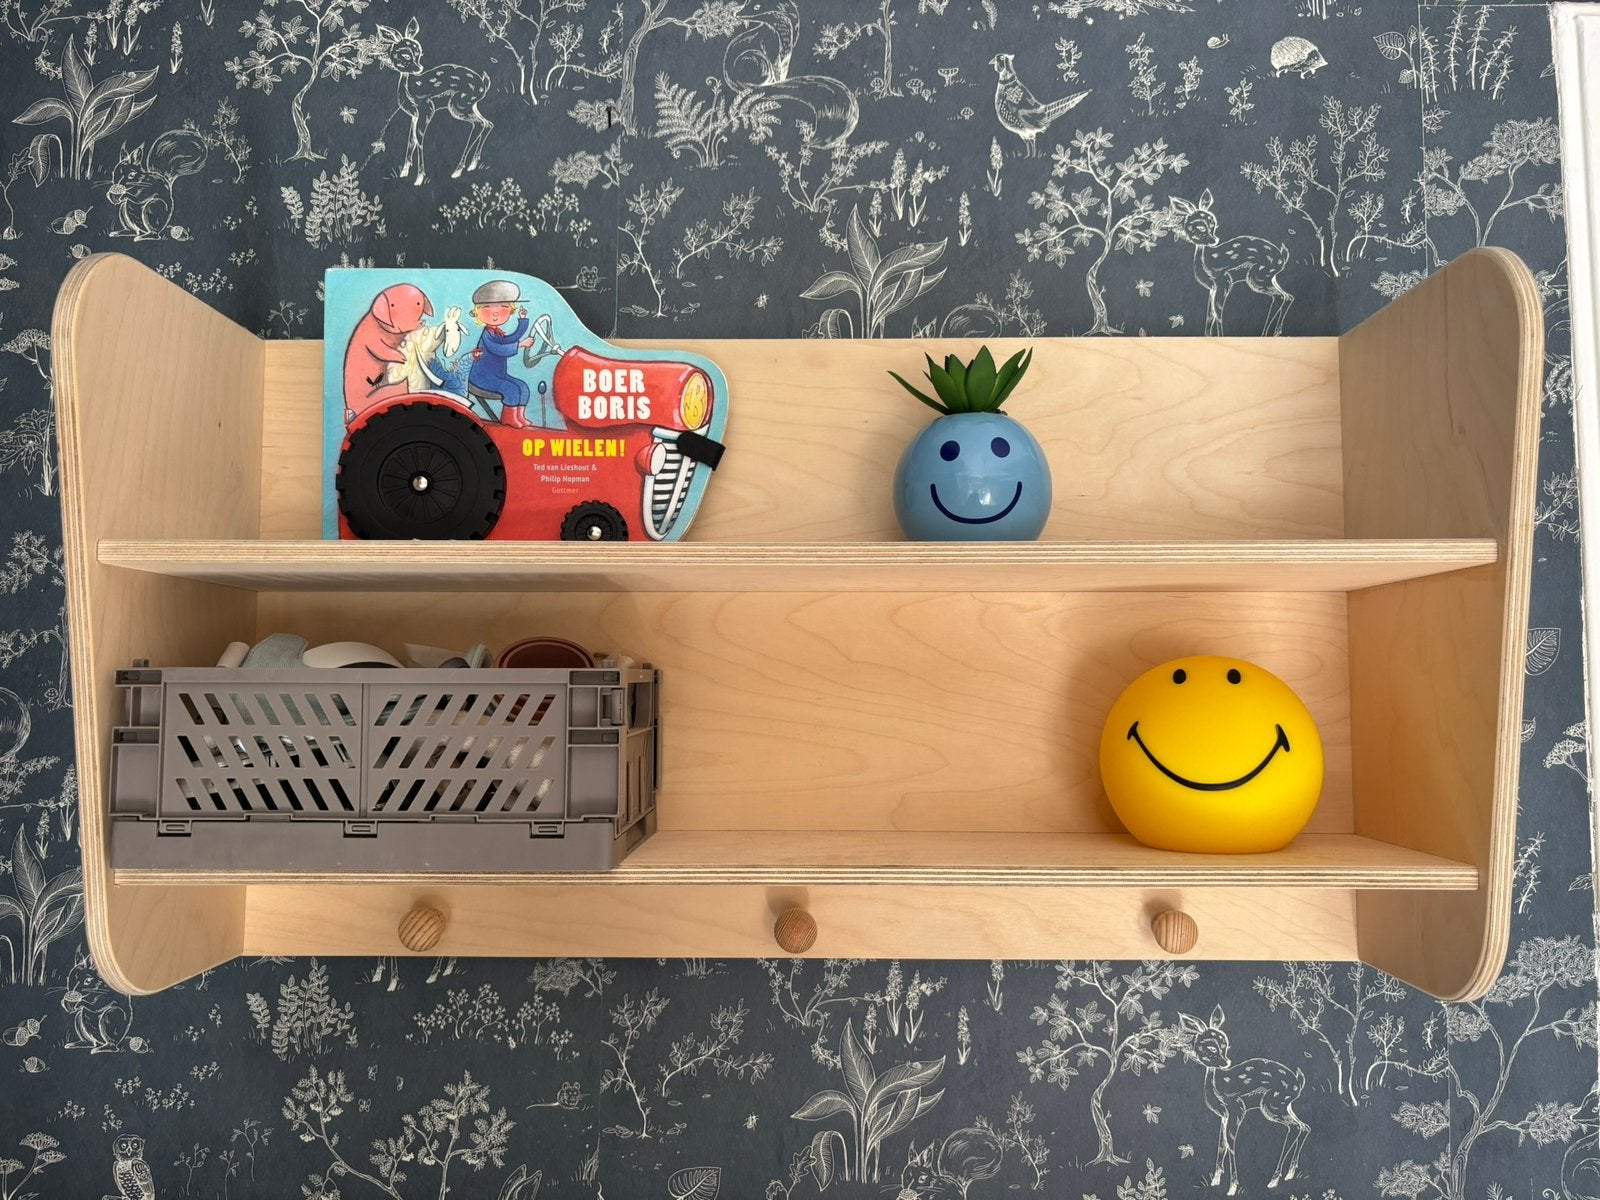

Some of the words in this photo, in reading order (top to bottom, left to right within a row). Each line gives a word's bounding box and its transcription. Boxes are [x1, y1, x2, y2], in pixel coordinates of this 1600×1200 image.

[583, 368, 646, 393] BOER
[578, 395, 651, 420] BORIS
[522, 438, 546, 457] OP
[550, 438, 625, 457] WIELEN!
[533, 463, 545, 471] Ted
[560, 463, 590, 471] Lieshout
[591, 463, 597, 471] &
[540, 474, 561, 484] Philip
[562, 474, 590, 484] Hopman
[551, 486, 579, 494] Gottmer
